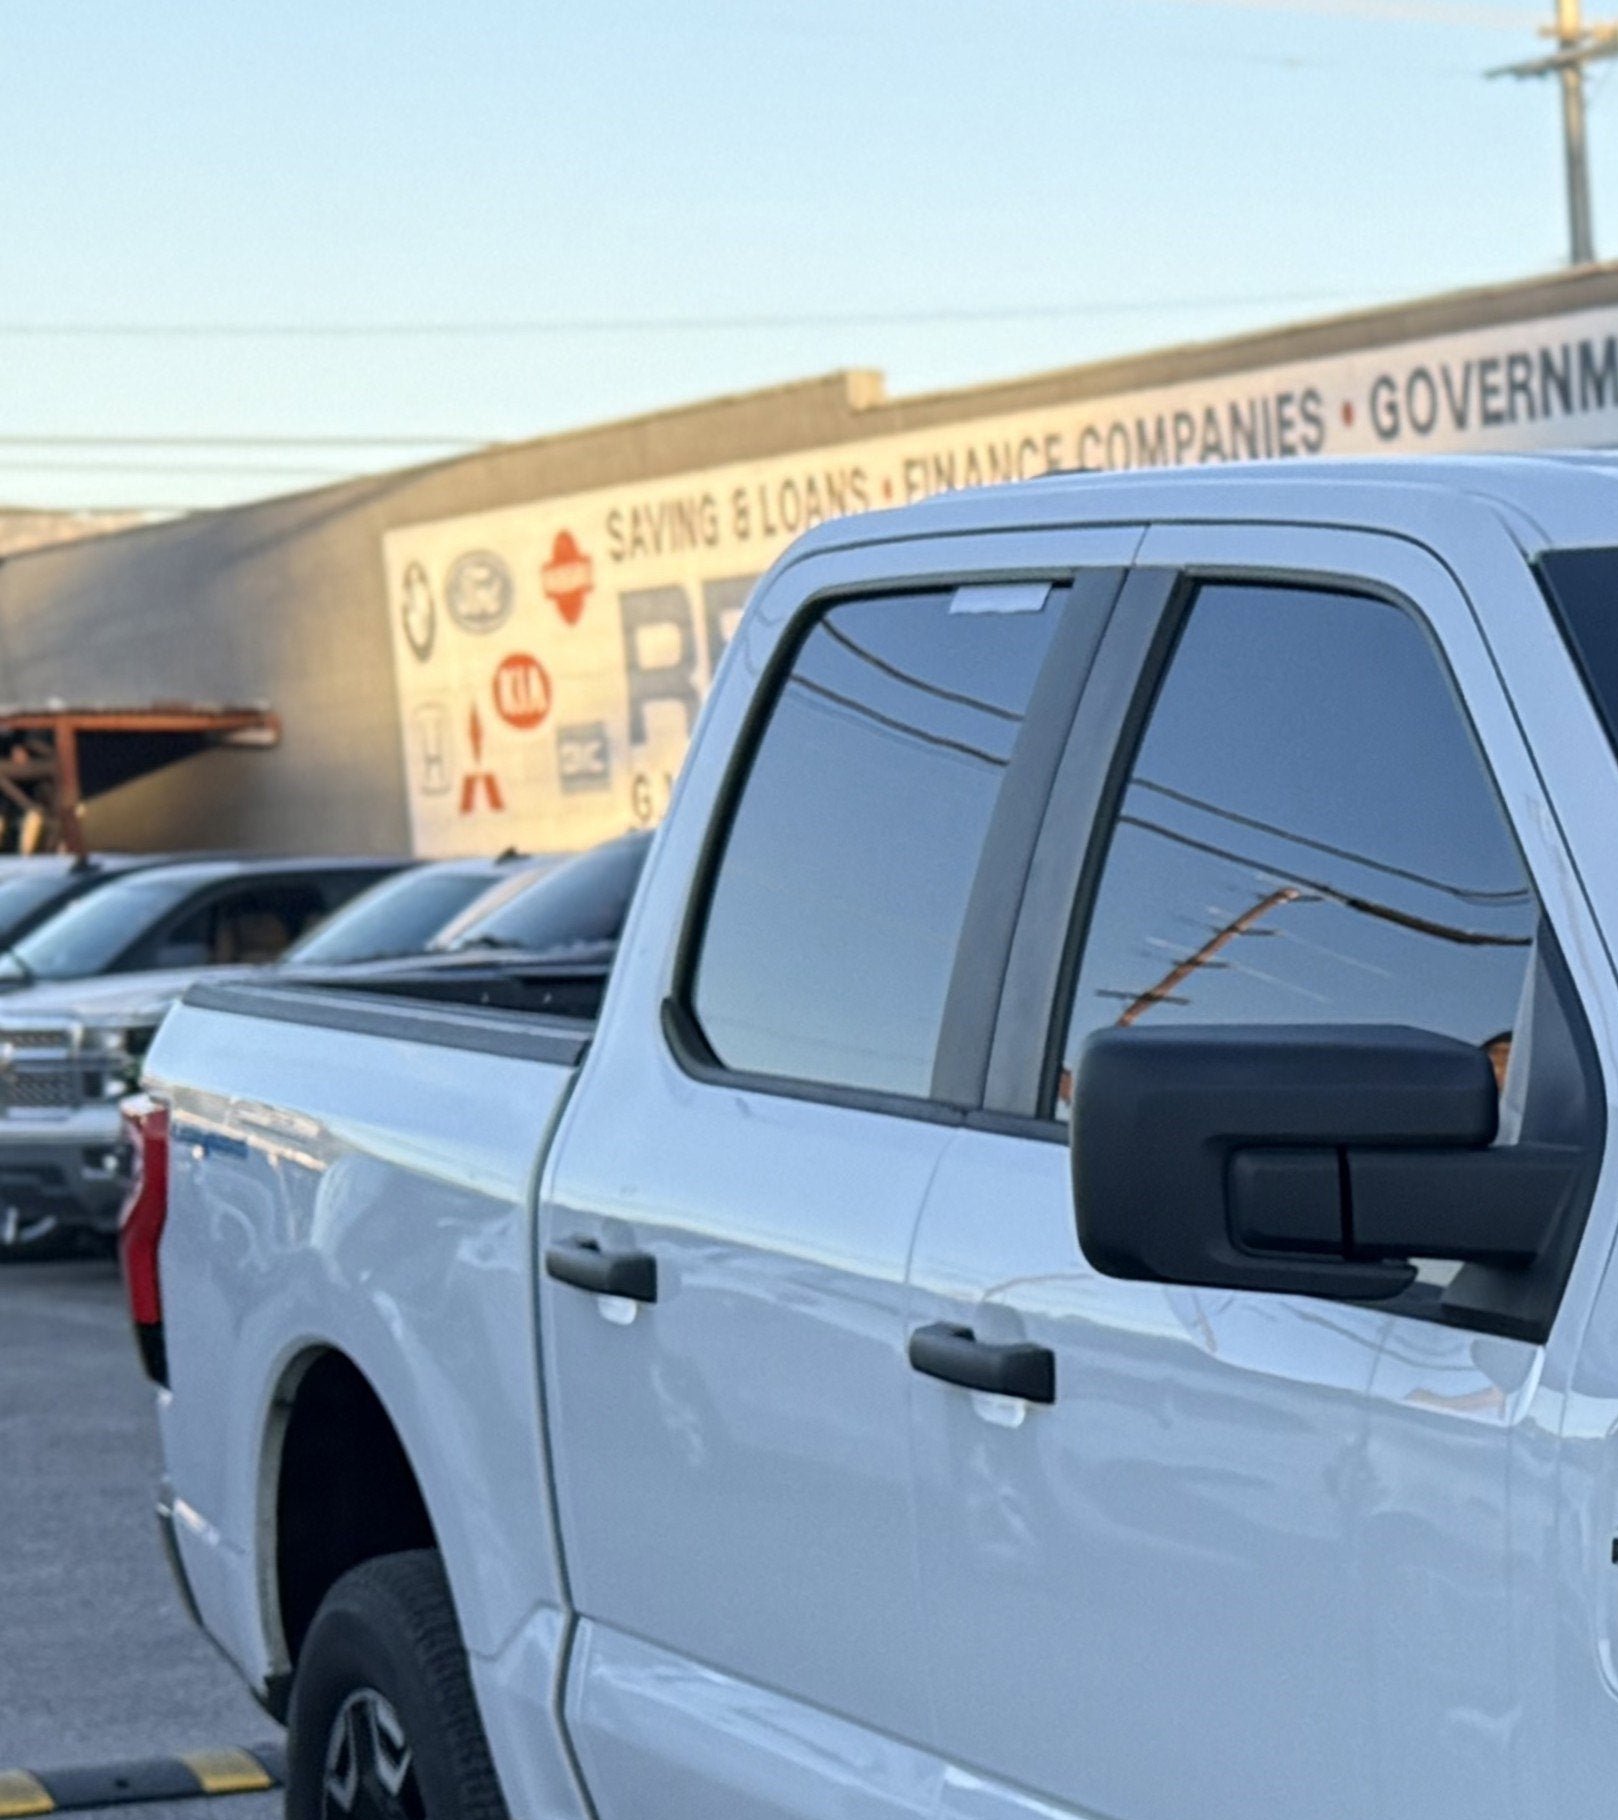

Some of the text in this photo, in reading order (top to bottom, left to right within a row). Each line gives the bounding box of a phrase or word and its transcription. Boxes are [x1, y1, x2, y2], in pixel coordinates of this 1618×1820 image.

[606, 493, 721, 563] SAVING
[762, 466, 870, 537] LOANS
[1078, 390, 1326, 471] COMPANIES
